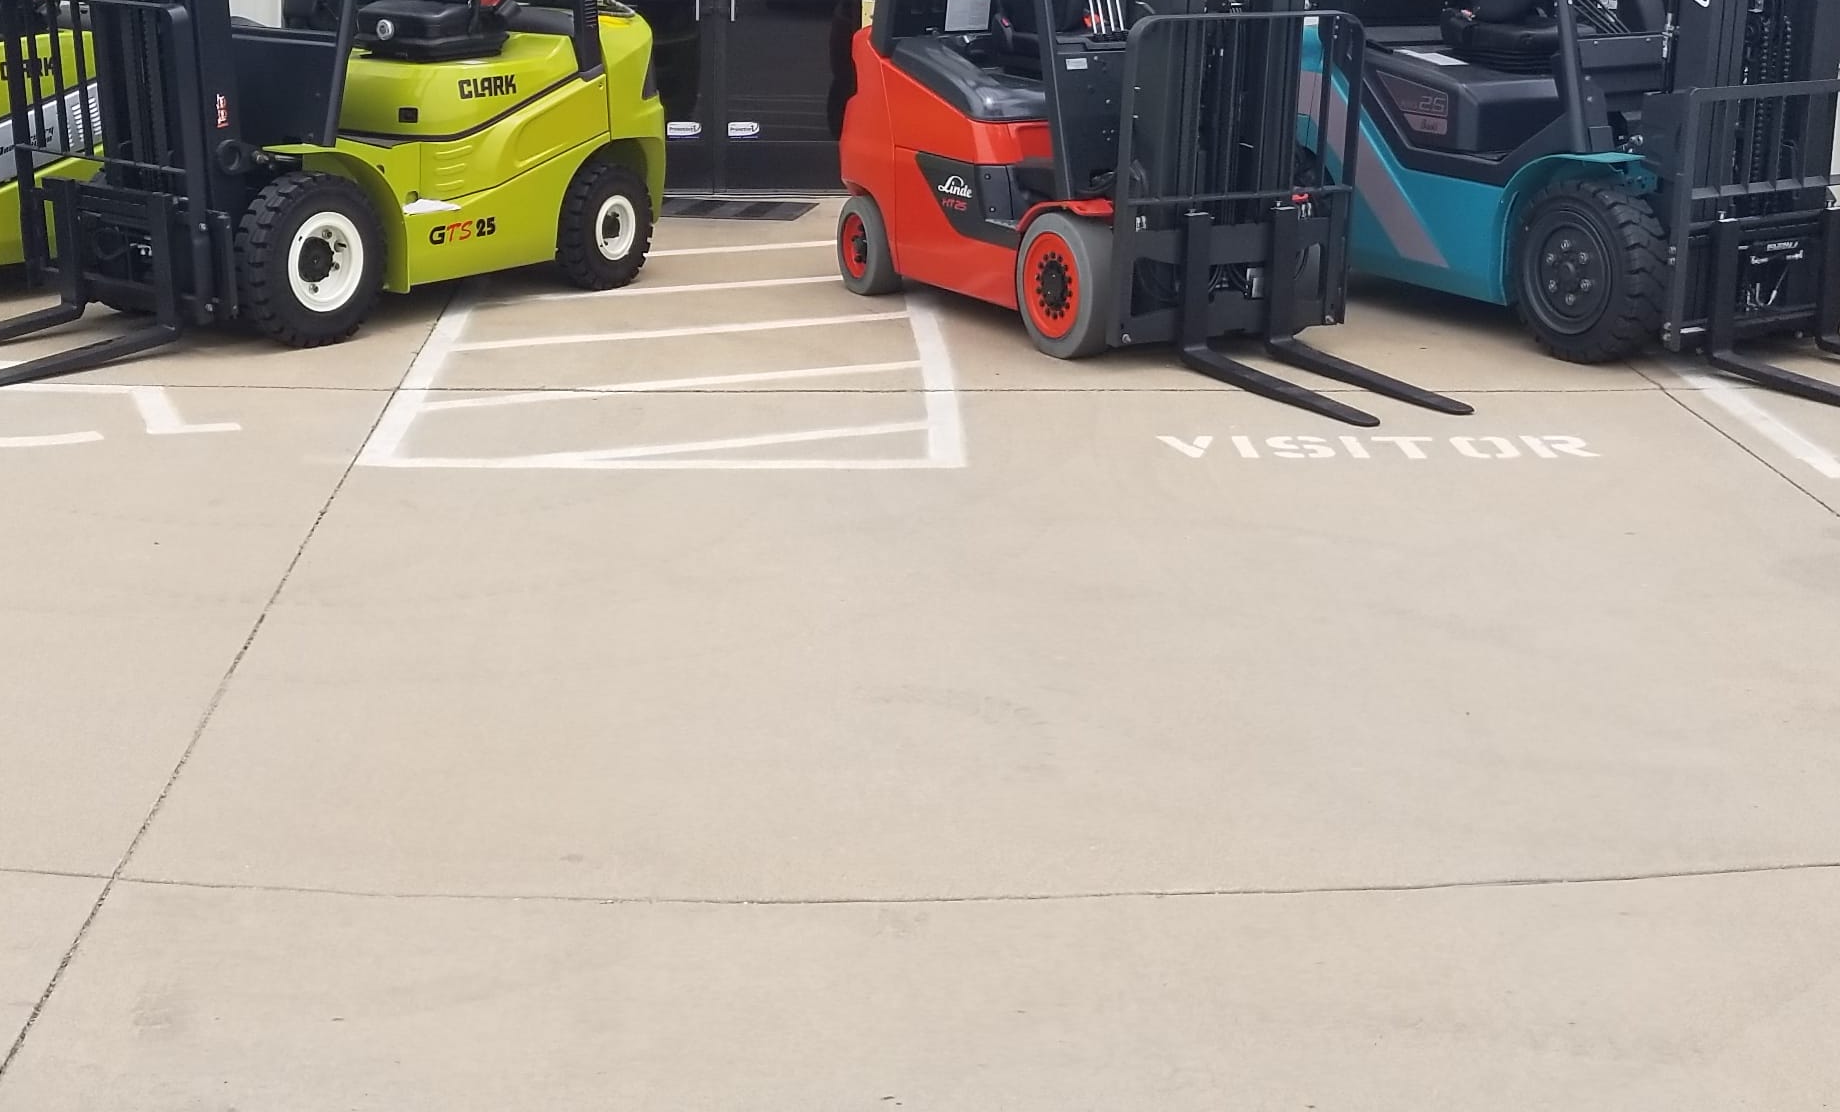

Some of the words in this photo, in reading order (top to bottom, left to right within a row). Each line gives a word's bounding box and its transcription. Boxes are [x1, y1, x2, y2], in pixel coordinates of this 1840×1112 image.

[458, 74, 517, 100] CLARK
[1419, 95, 1446, 113] 25
[937, 175, 973, 198] Linde
[429, 220, 473, 246] GTS
[476, 216, 496, 238] 25
[1155, 434, 1603, 460] VISITOR
